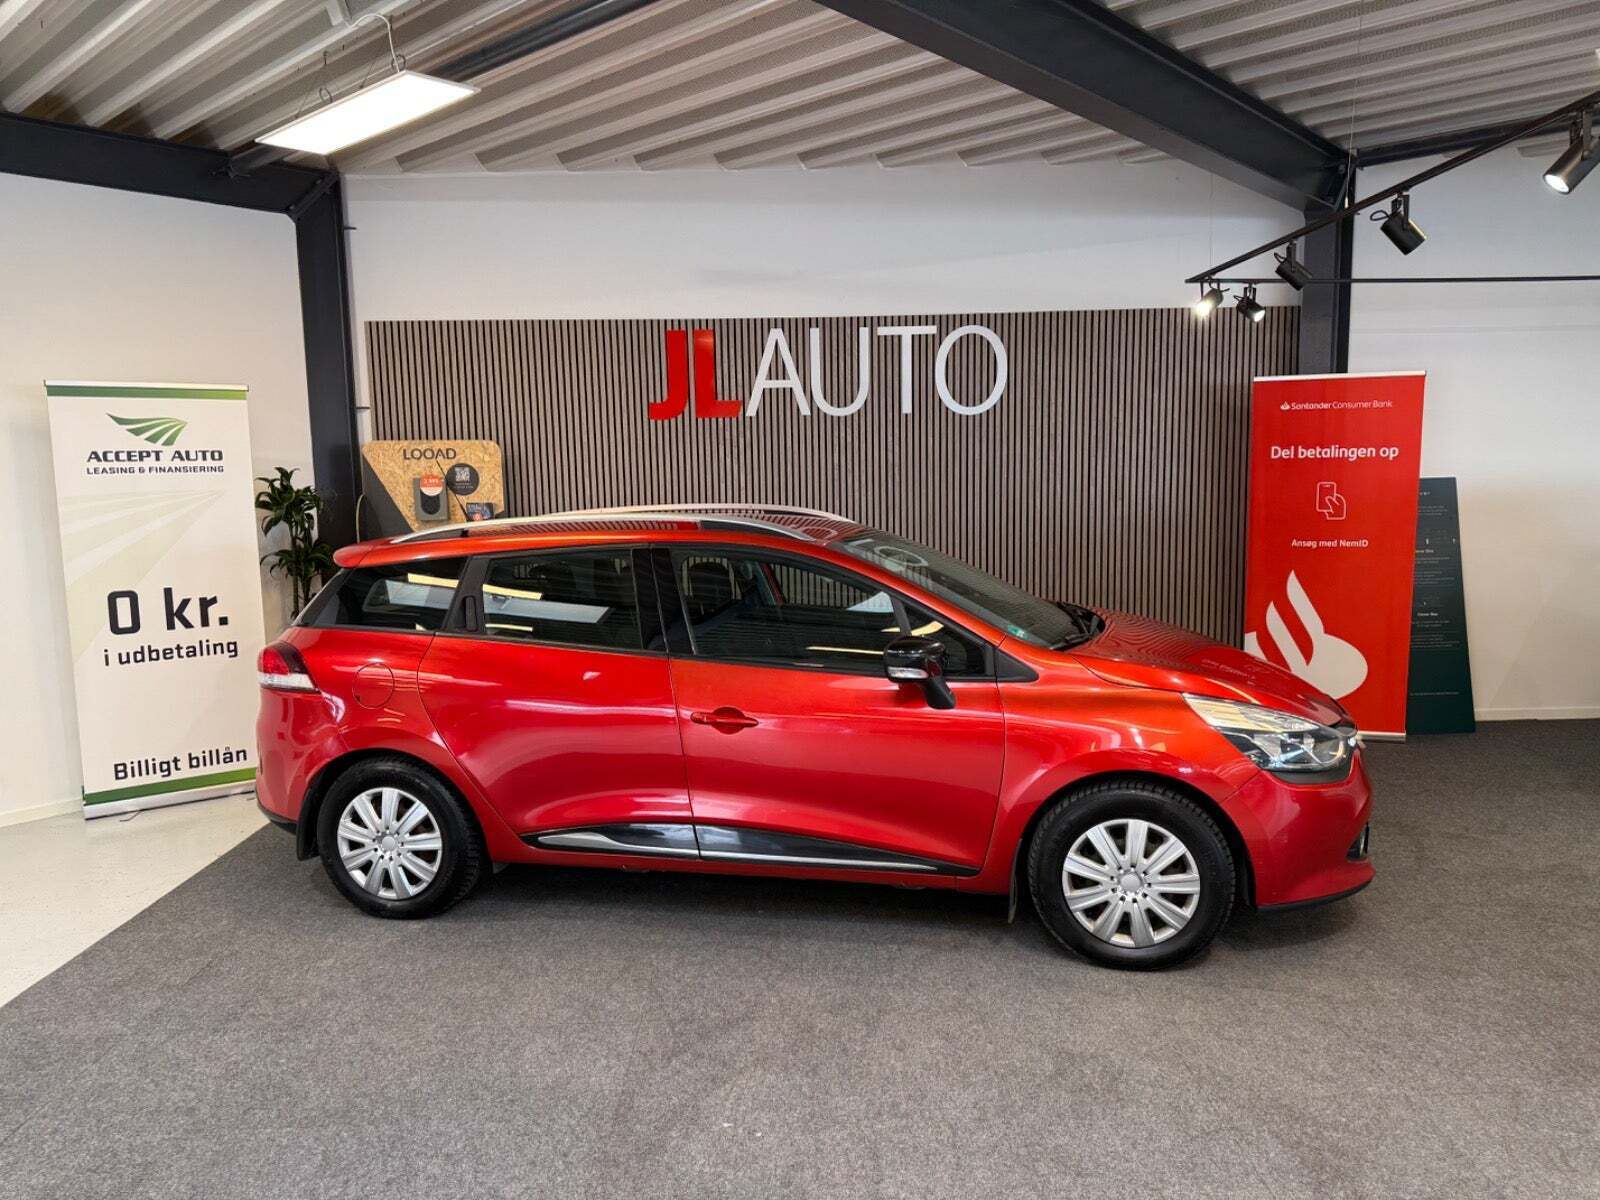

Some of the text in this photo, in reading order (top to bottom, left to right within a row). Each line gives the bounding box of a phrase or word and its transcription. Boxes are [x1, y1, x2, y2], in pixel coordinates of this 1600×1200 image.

[1291, 400, 1393, 410] Santander Consumer Bank
[87, 450, 223, 462] ACCEPT AUTO
[403, 448, 457, 460] LOOAD
[1271, 445, 1399, 461] Del betalingen op
[87, 467, 135, 475] LEASING
[149, 465, 224, 474] FINANSIERING
[1292, 539, 1369, 549] Ansøg med NemID
[107, 587, 229, 635] 0 kr.
[104, 639, 238, 667] i udbetaling
[114, 746, 247, 781] Billigt billån
